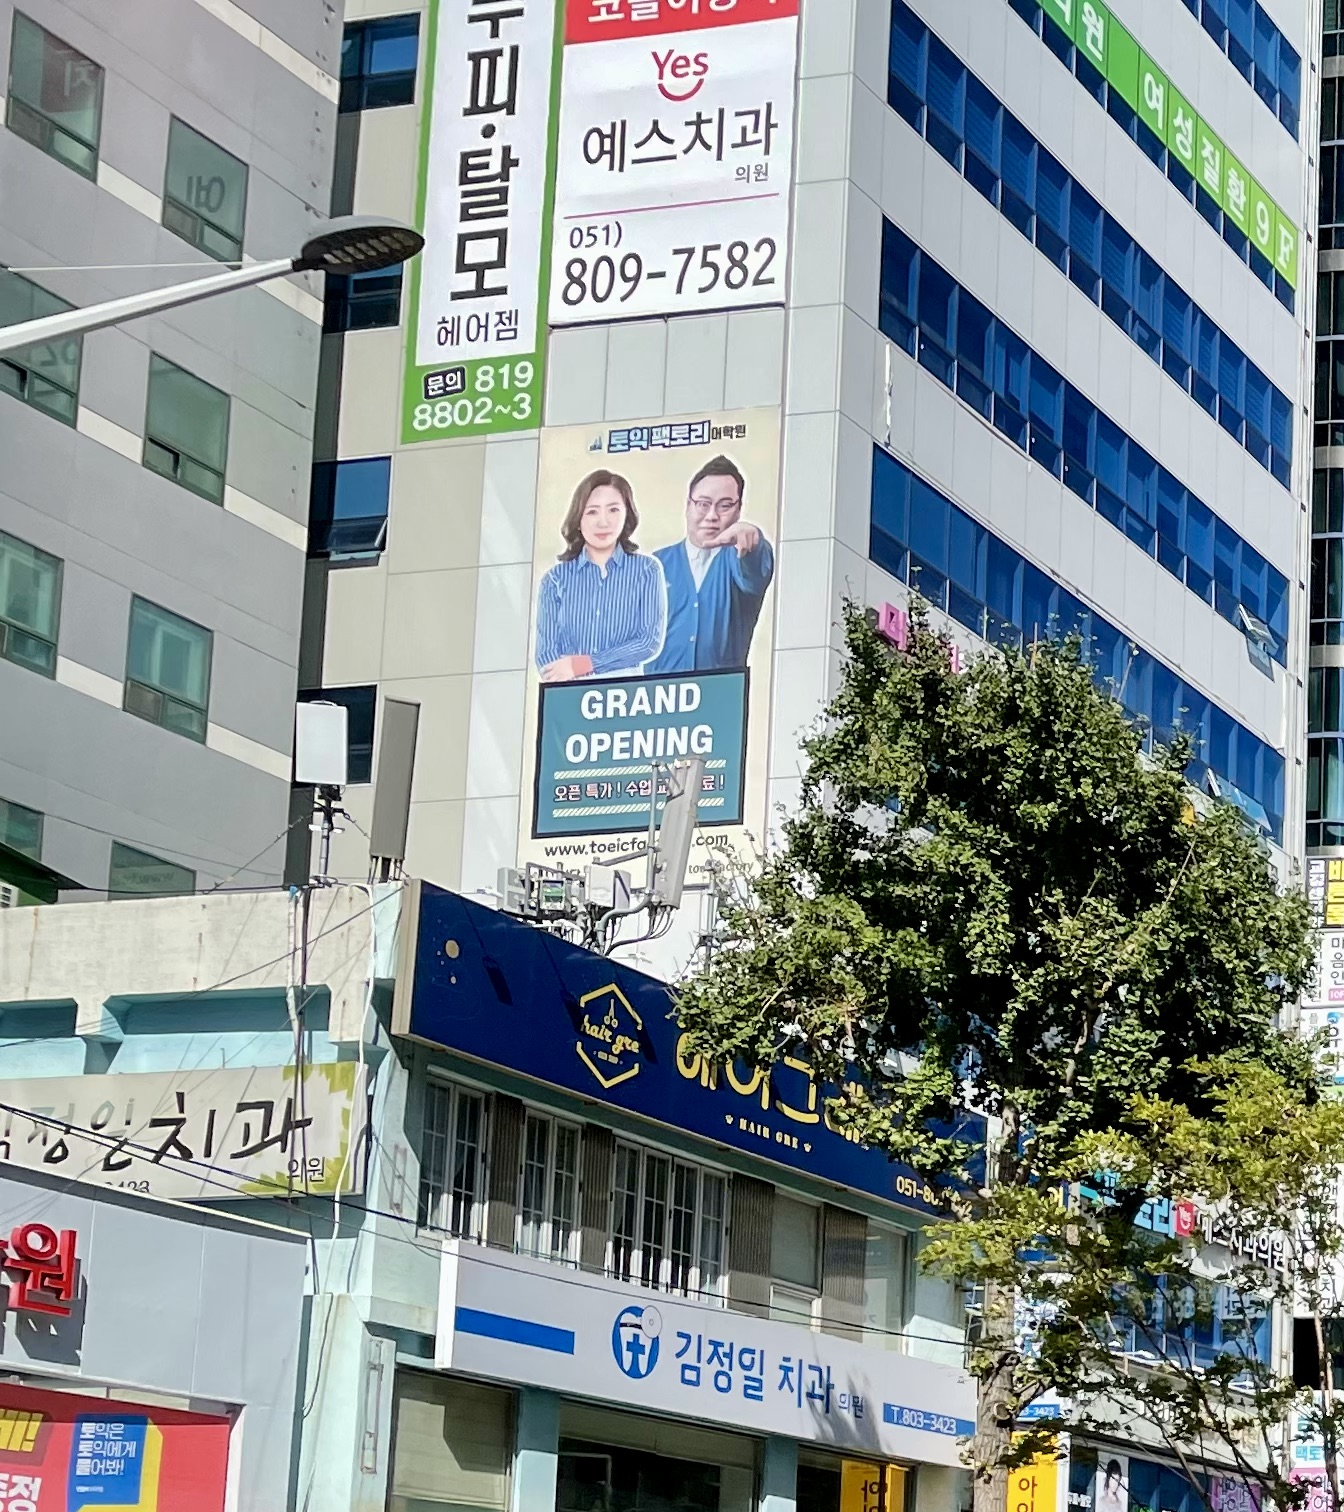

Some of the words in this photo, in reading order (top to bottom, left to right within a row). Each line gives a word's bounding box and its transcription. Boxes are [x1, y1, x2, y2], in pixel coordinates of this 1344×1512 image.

[651, 50, 709, 80] Yes
[583, 102, 779, 173] 예스치과
[1143, 70, 1250, 223] 여성질환
[734, 162, 769, 184] 의원
[569, 221, 623, 249] 051)
[562, 237, 777, 306] 809-7582
[437, 309, 520, 347] 헤어젬
[426, 369, 464, 395] 문의
[475, 361, 535, 392] 819
[412, 393, 532, 431] 8802~3
[607, 420, 711, 454] 토익팩토리
[580, 682, 702, 721] GRAND
[565, 725, 714, 763] OPENING
[554, 783, 581, 802] 오픈
[625, 778, 653, 797] 수업
[581, 1015, 613, 1042] hair
[287, 1157, 326, 1184] 의원
[0, 1223, 78, 1317] 원
[673, 1330, 764, 1401] 김정일
[777, 1356, 835, 1415] 치과
[79, 1421, 125, 1440] 토익은
[891, 1405, 958, 1435] T.803-3423
[76, 1440, 137, 1458] 토익에게
[75, 1458, 125, 1476] 물어봐!
